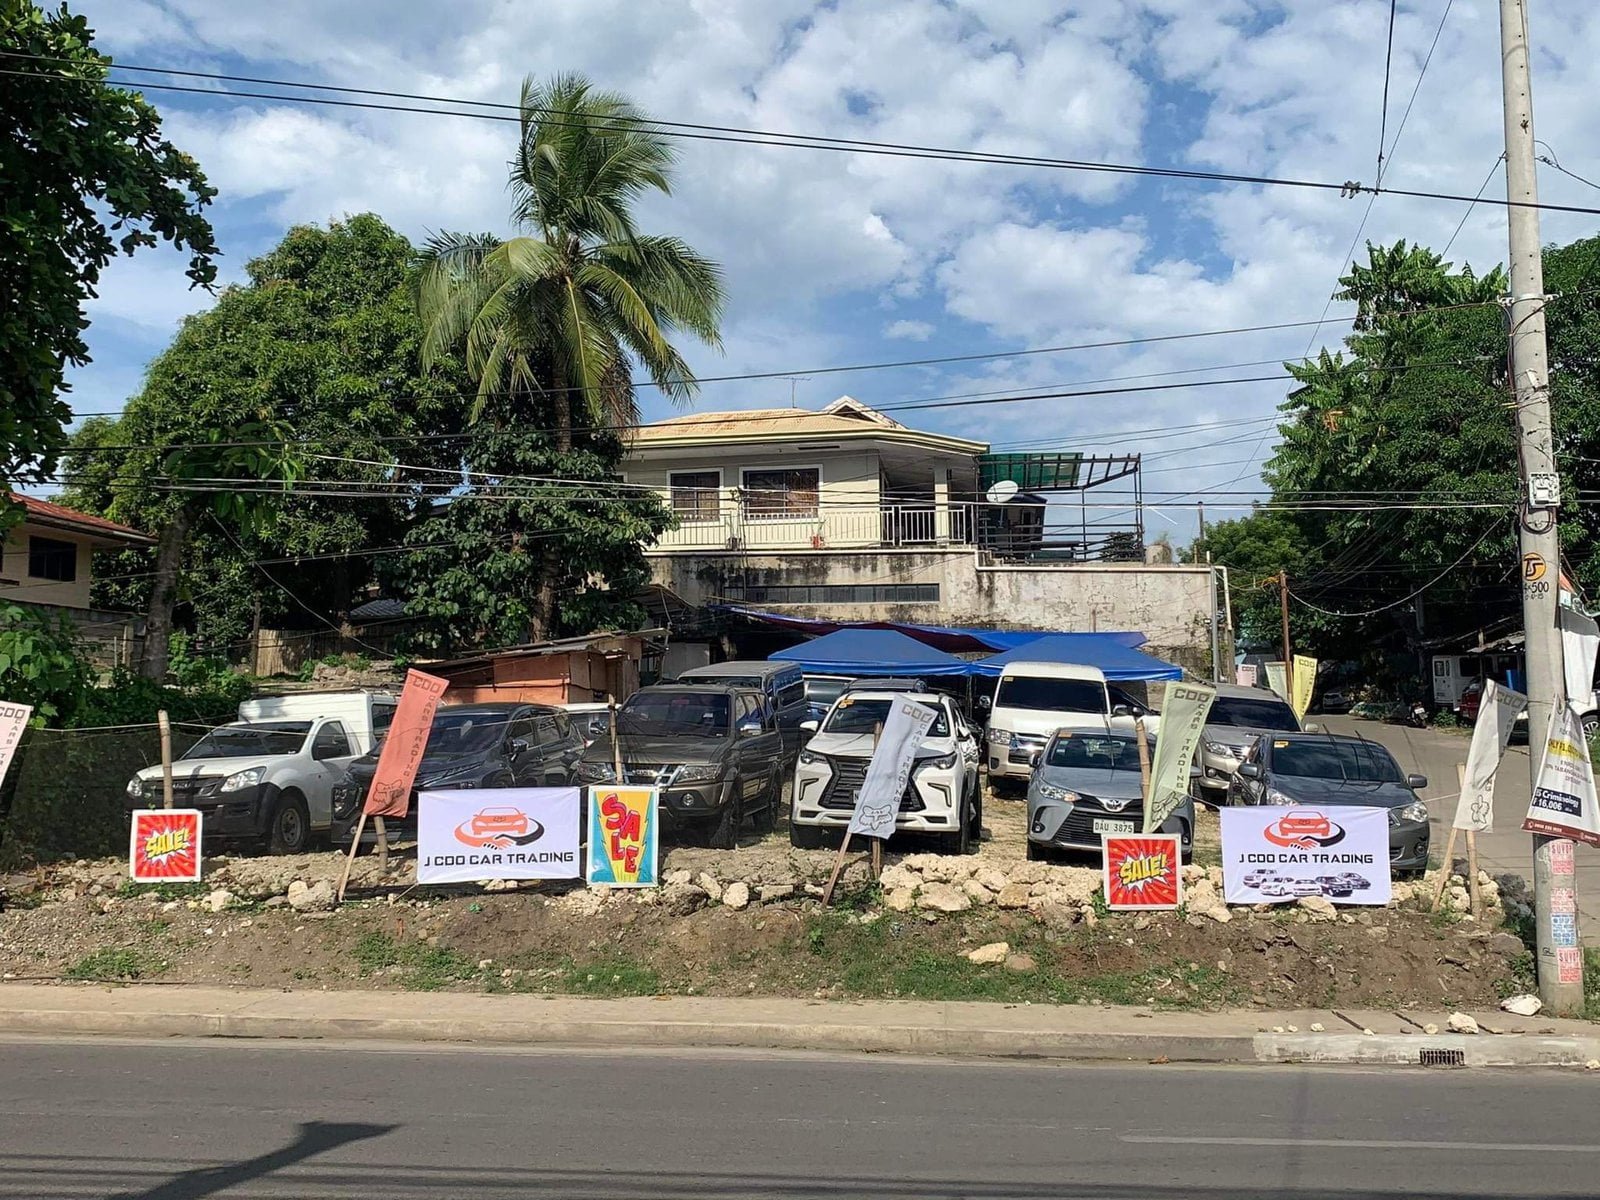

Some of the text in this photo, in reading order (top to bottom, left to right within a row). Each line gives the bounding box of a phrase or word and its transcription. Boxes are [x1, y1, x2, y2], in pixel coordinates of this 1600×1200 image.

[145, 827, 190, 859] SALE!
[469, 854, 502, 865] CAR
[507, 852, 574, 864] TRADING
[1119, 853, 1167, 885] SALE!
[1279, 853, 1308, 863] CAR
[1312, 853, 1374, 864] TRADING
